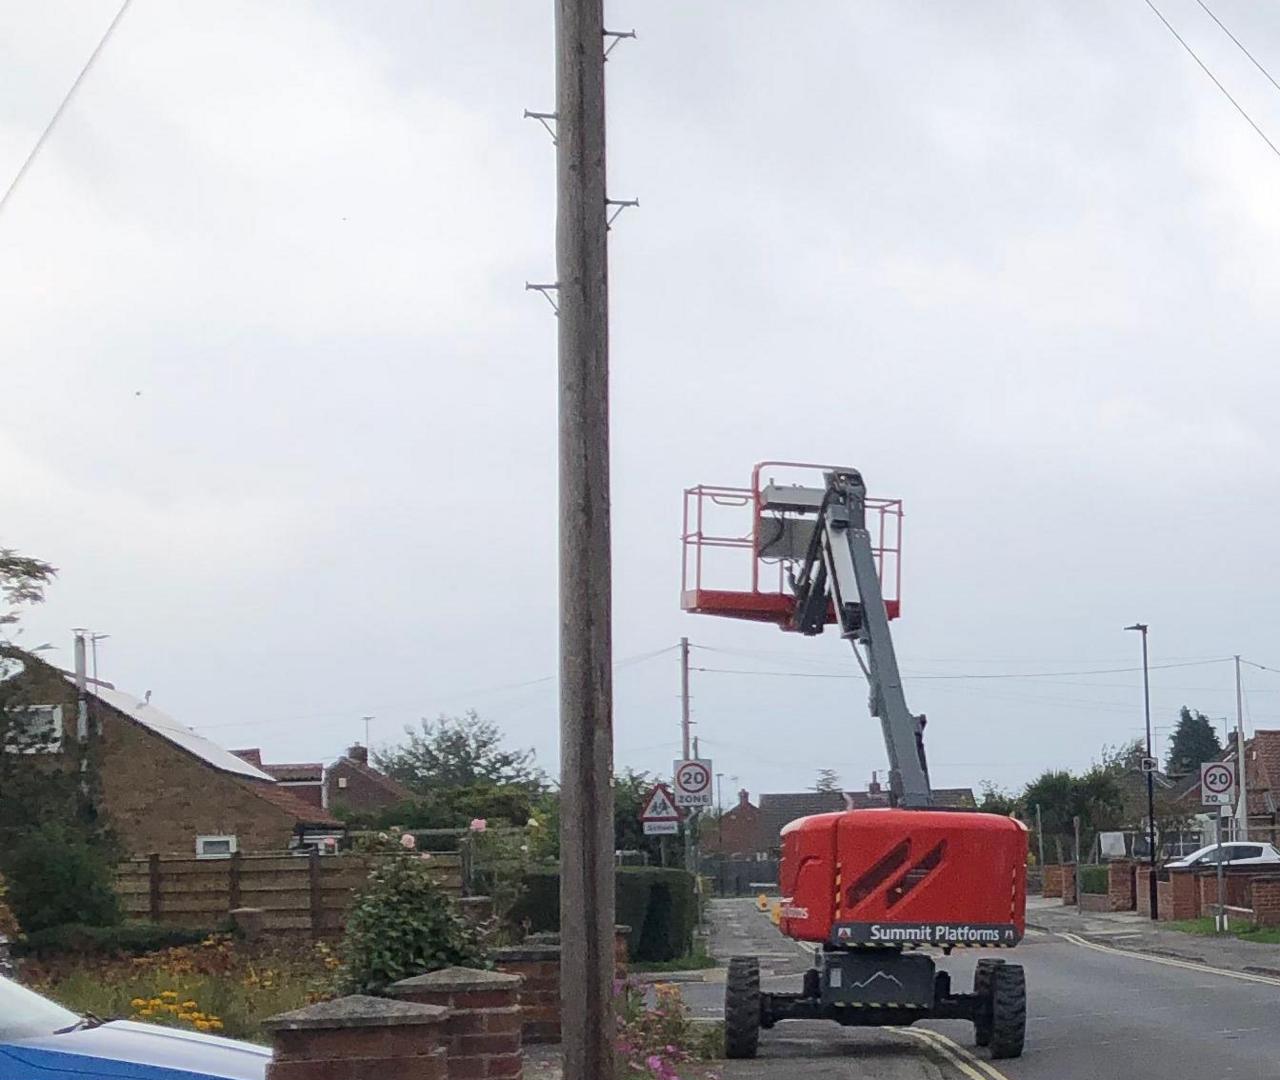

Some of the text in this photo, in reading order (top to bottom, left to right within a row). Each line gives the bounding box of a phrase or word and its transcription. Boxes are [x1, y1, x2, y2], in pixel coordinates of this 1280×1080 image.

[682, 772, 704, 785] 20
[1209, 773, 1228, 785] 20
[678, 795, 708, 803] ZONE
[870, 925, 1000, 941] Summit Platforms
